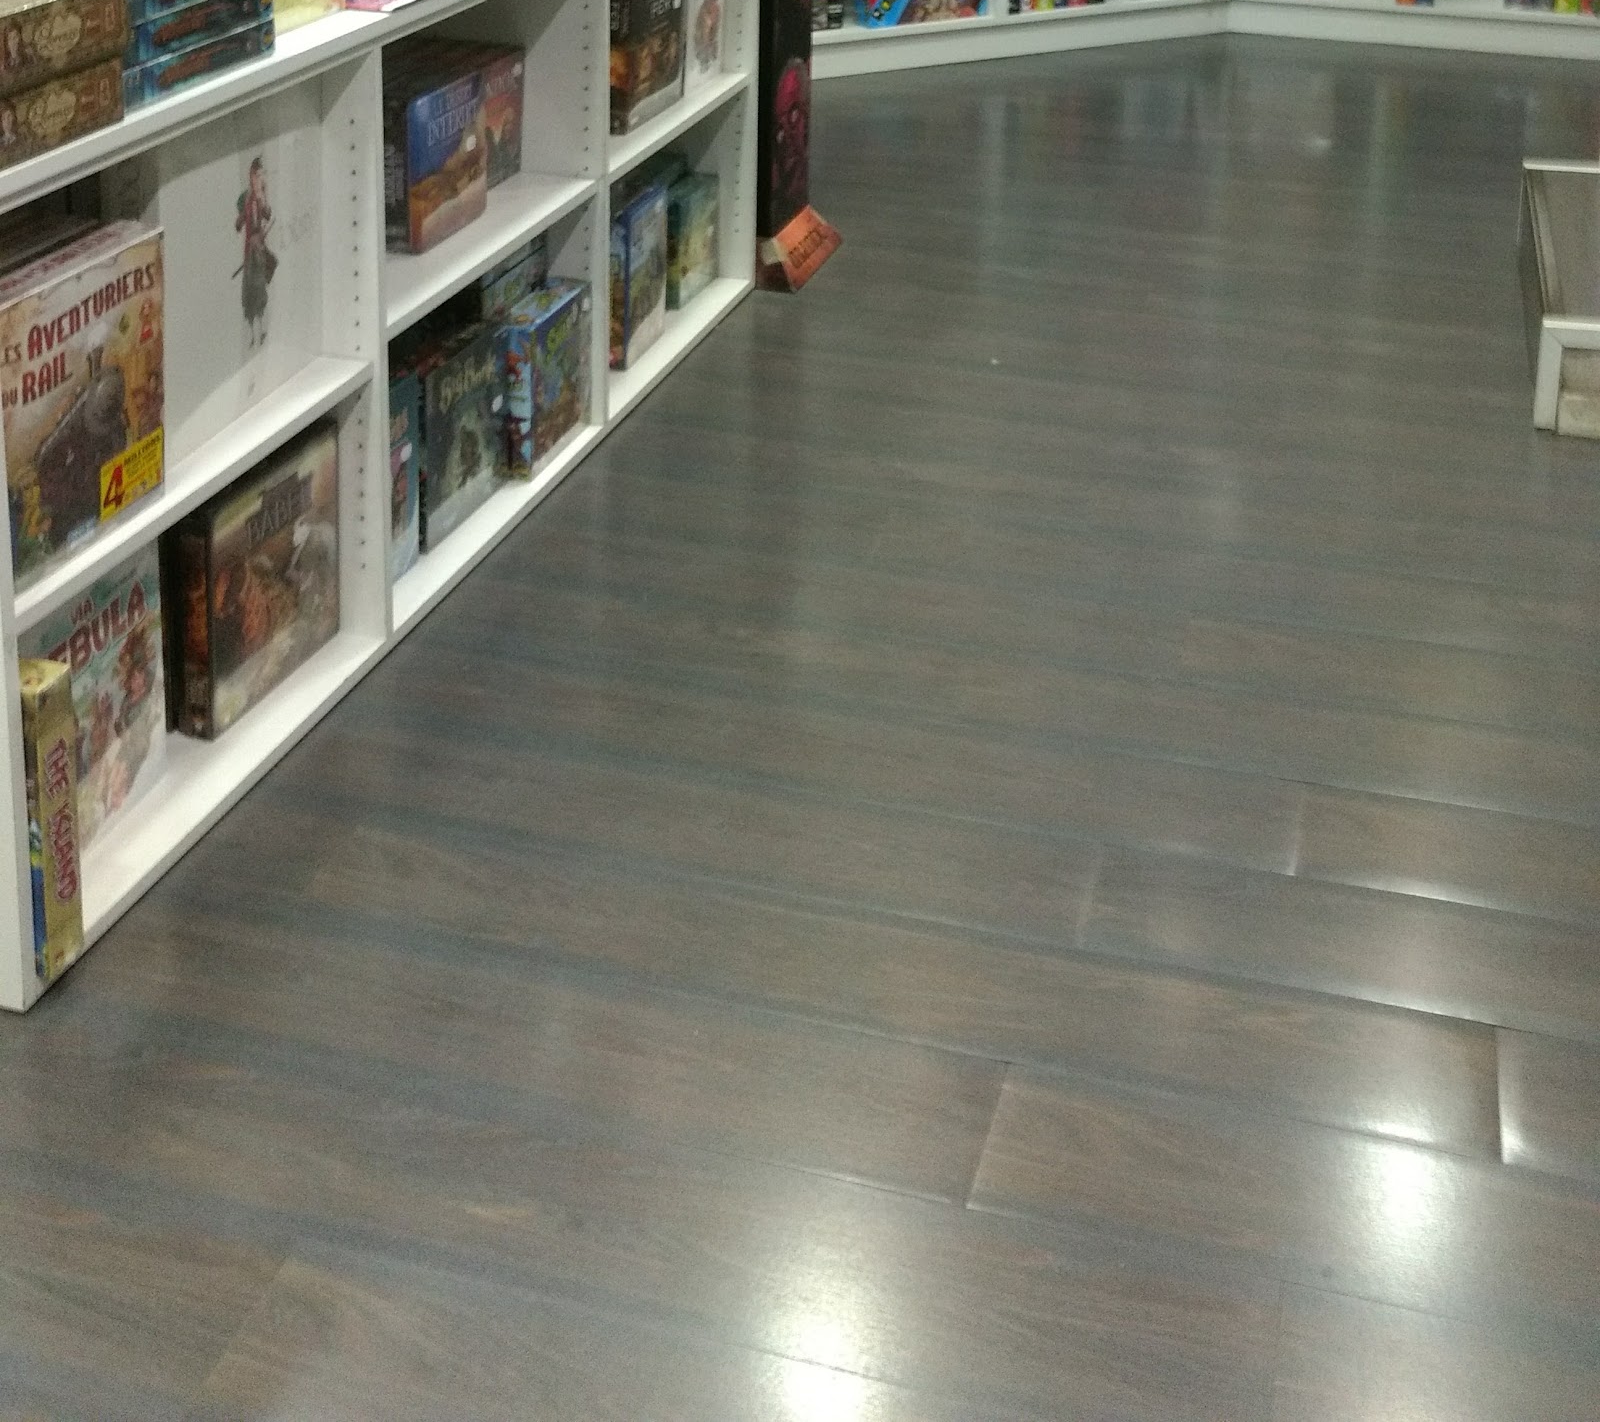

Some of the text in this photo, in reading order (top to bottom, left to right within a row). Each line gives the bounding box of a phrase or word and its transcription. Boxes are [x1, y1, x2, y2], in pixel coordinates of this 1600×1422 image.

[0, 342, 22, 365] ES
[28, 262, 156, 362] AVENTURIERS
[22, 350, 74, 406] RAIL
[103, 463, 125, 509] 4
[47, 579, 147, 676] EBULA
